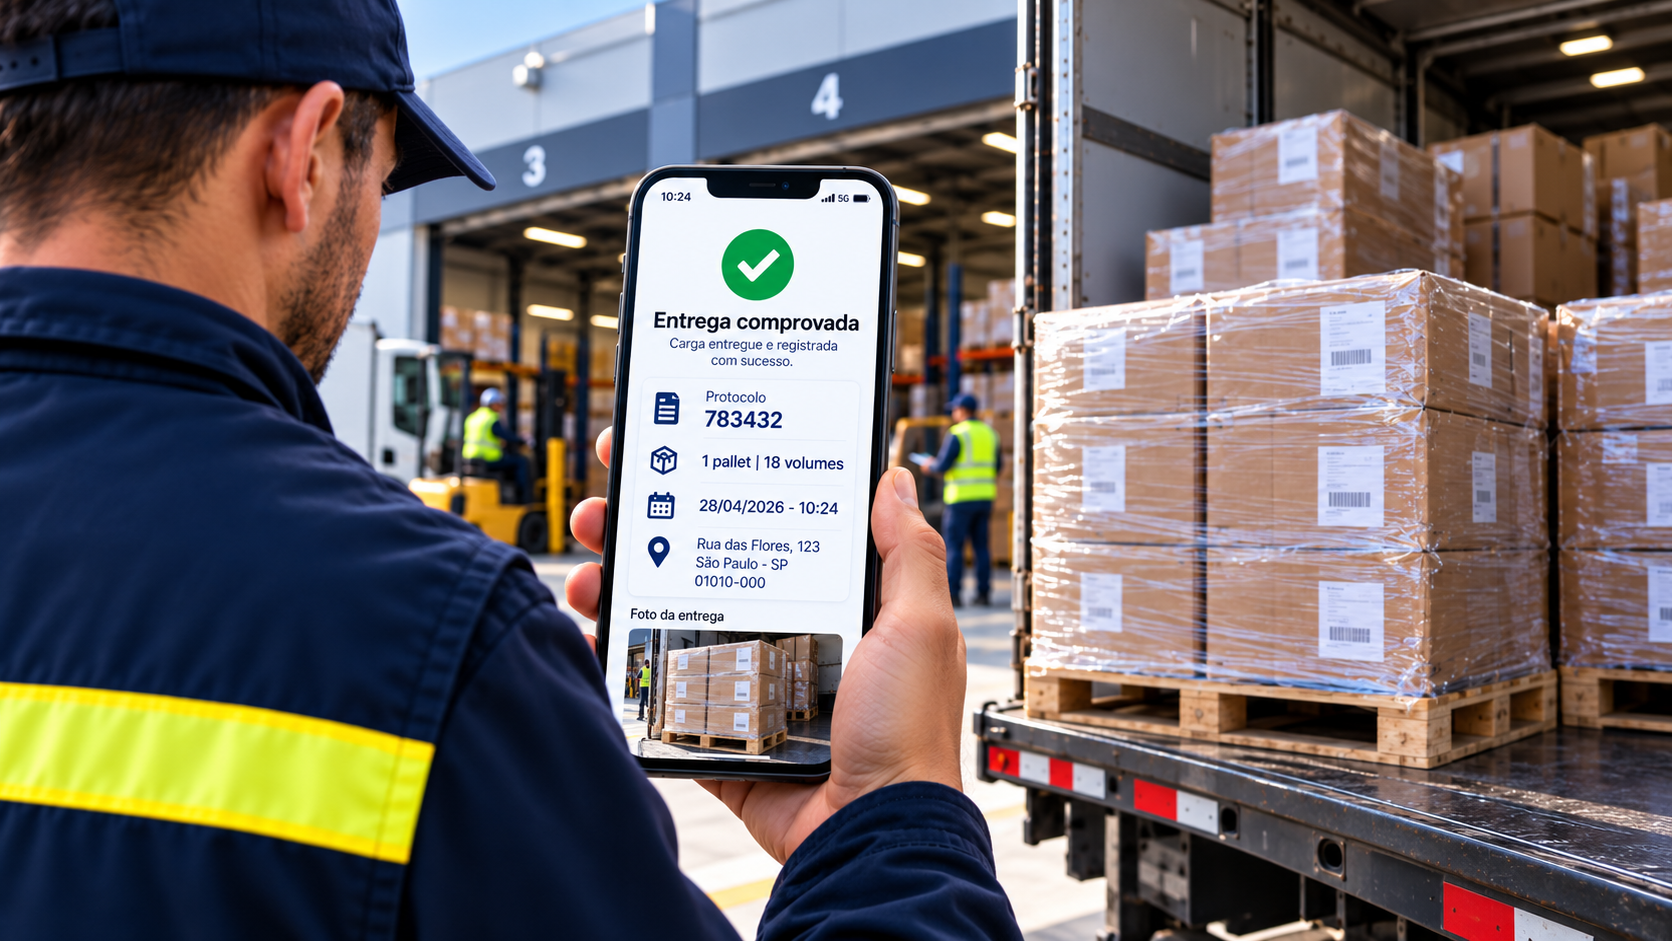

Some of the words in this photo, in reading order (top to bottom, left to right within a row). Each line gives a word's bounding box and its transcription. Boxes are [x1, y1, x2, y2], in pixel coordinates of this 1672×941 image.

[811, 72, 844, 120] 4
[522, 144, 547, 188] 3
[661, 192, 691, 201] 10:24
[837, 194, 849, 202] 5G
[654, 312, 731, 333] Entrega
[737, 314, 859, 334] comprovada
[670, 337, 705, 351] Carga
[709, 339, 762, 352] entregue
[766, 342, 773, 350] e
[777, 340, 837, 353] registrada
[711, 357, 737, 365] com
[741, 358, 792, 366] sucesso.
[706, 391, 766, 403] Protocolo
[705, 410, 782, 428] 783432
[702, 455, 708, 467] 1
[713, 455, 751, 470] pallet
[764, 456, 780, 469] 18
[785, 456, 844, 470] volumes
[699, 499, 784, 515] 28/04/2026
[799, 502, 838, 514] 10:24
[697, 538, 721, 550] Rua
[725, 538, 747, 551] das
[752, 539, 792, 554] Flores,
[798, 540, 820, 553] 123
[724, 557, 758, 569] Paulo
[771, 558, 788, 570] SP
[695, 575, 765, 588] 01010-000
[631, 608, 657, 620] Foto
[660, 609, 675, 620] da
[678, 611, 724, 624] entrega
